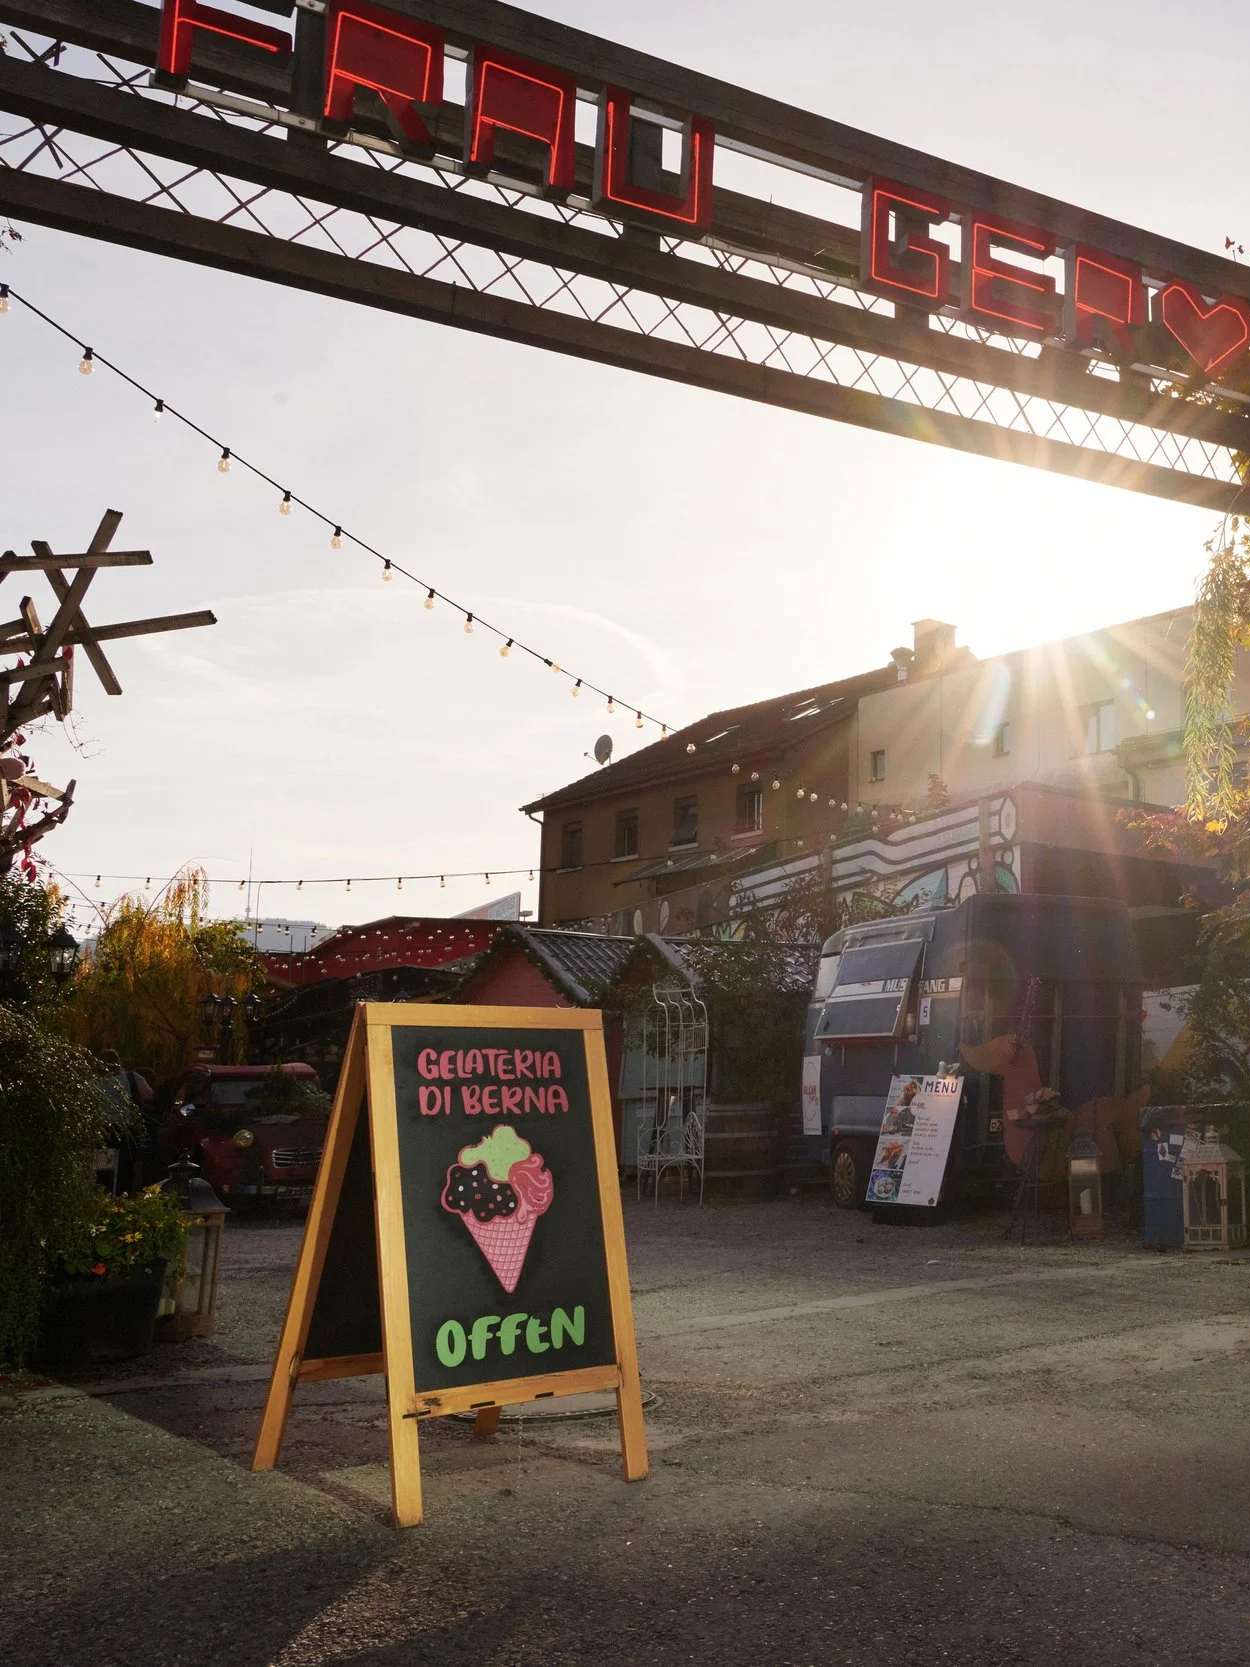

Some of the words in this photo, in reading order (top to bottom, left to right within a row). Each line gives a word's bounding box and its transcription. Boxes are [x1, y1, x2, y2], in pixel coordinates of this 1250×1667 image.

[417, 1048, 562, 1080] GELATERIA
[418, 1085, 451, 1116] DI
[461, 1084, 570, 1115] BERNA
[924, 1080, 958, 1094] MENU
[435, 1305, 586, 1368] OFFEN
